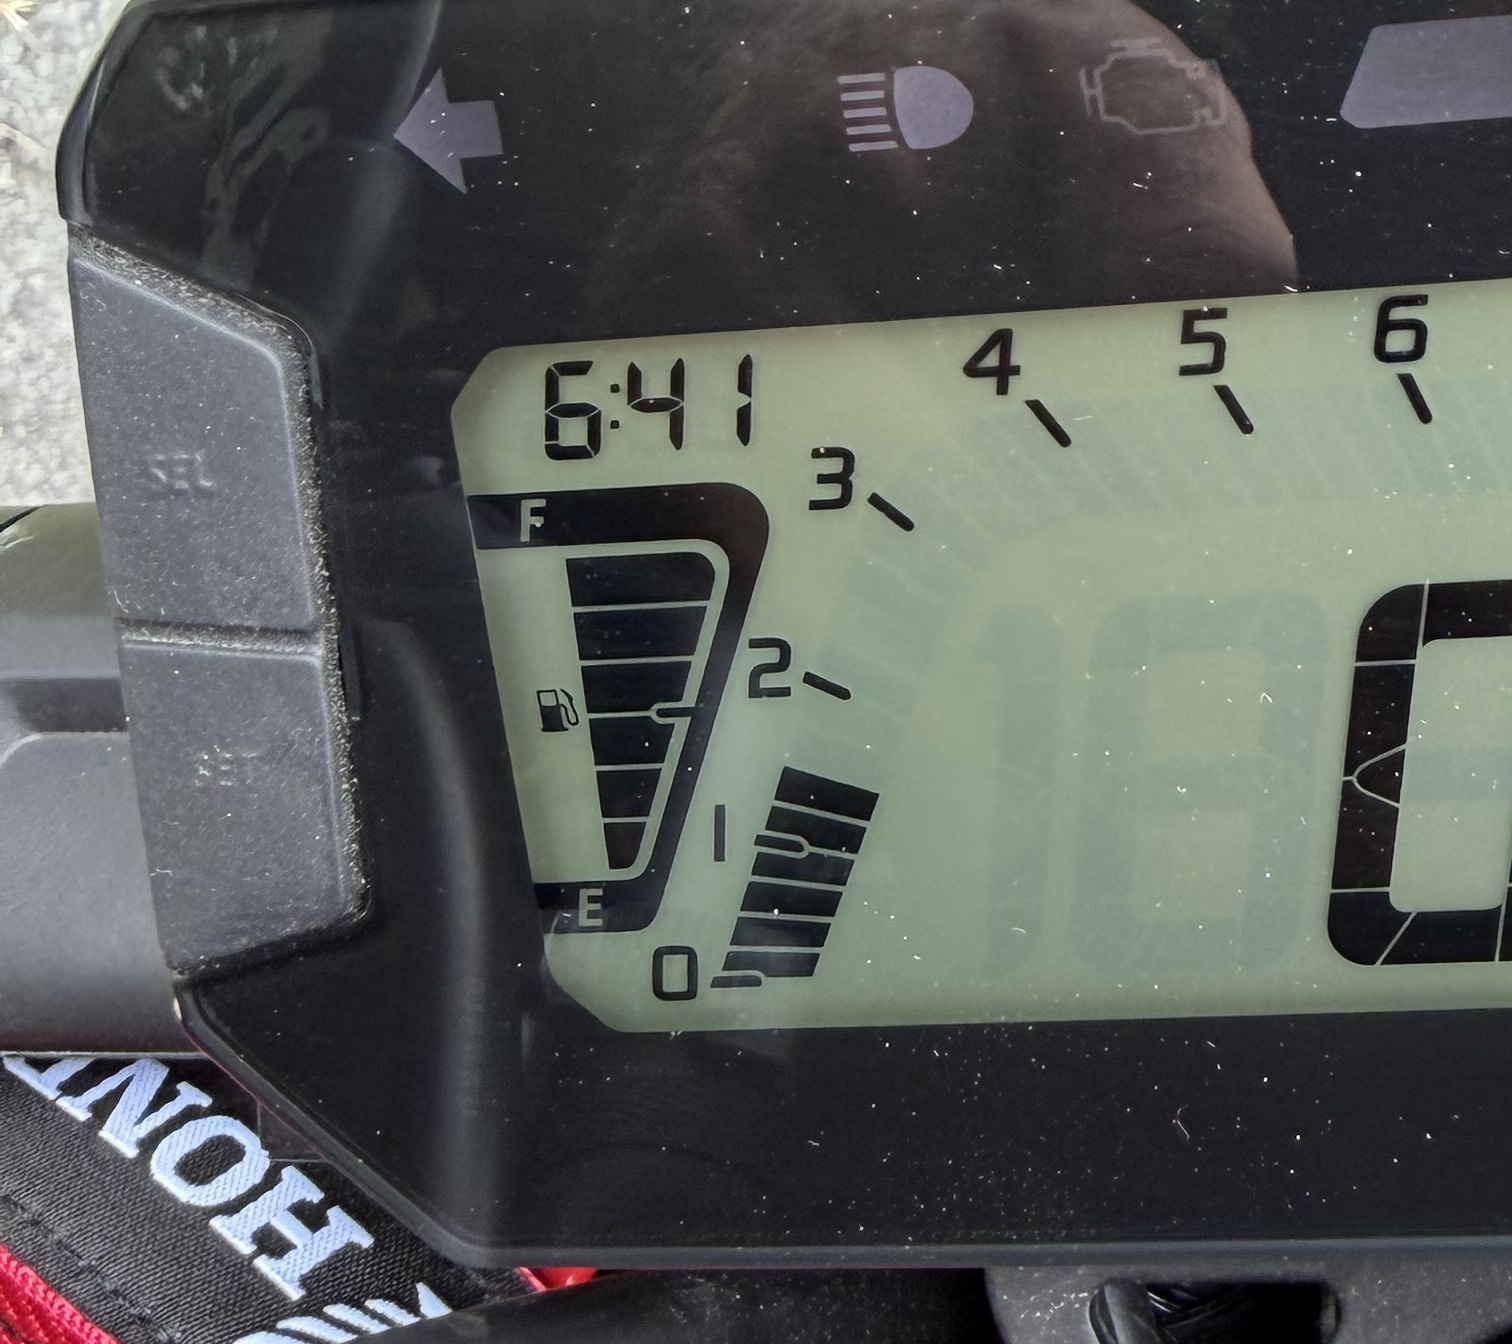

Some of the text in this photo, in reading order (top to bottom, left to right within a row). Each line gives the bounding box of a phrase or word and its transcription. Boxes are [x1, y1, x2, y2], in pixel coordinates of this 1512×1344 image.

[962, 328, 1022, 396] 4
[1178, 306, 1229, 378] 5
[1372, 294, 1429, 364] 6
[545, 353, 753, 460] 6:41
[809, 446, 856, 510] 3
[518, 499, 546, 543] F
[748, 637, 792, 699] 2
[713, 803, 727, 862] 1
[577, 889, 604, 928] E
[651, 945, 699, 1001] 0
